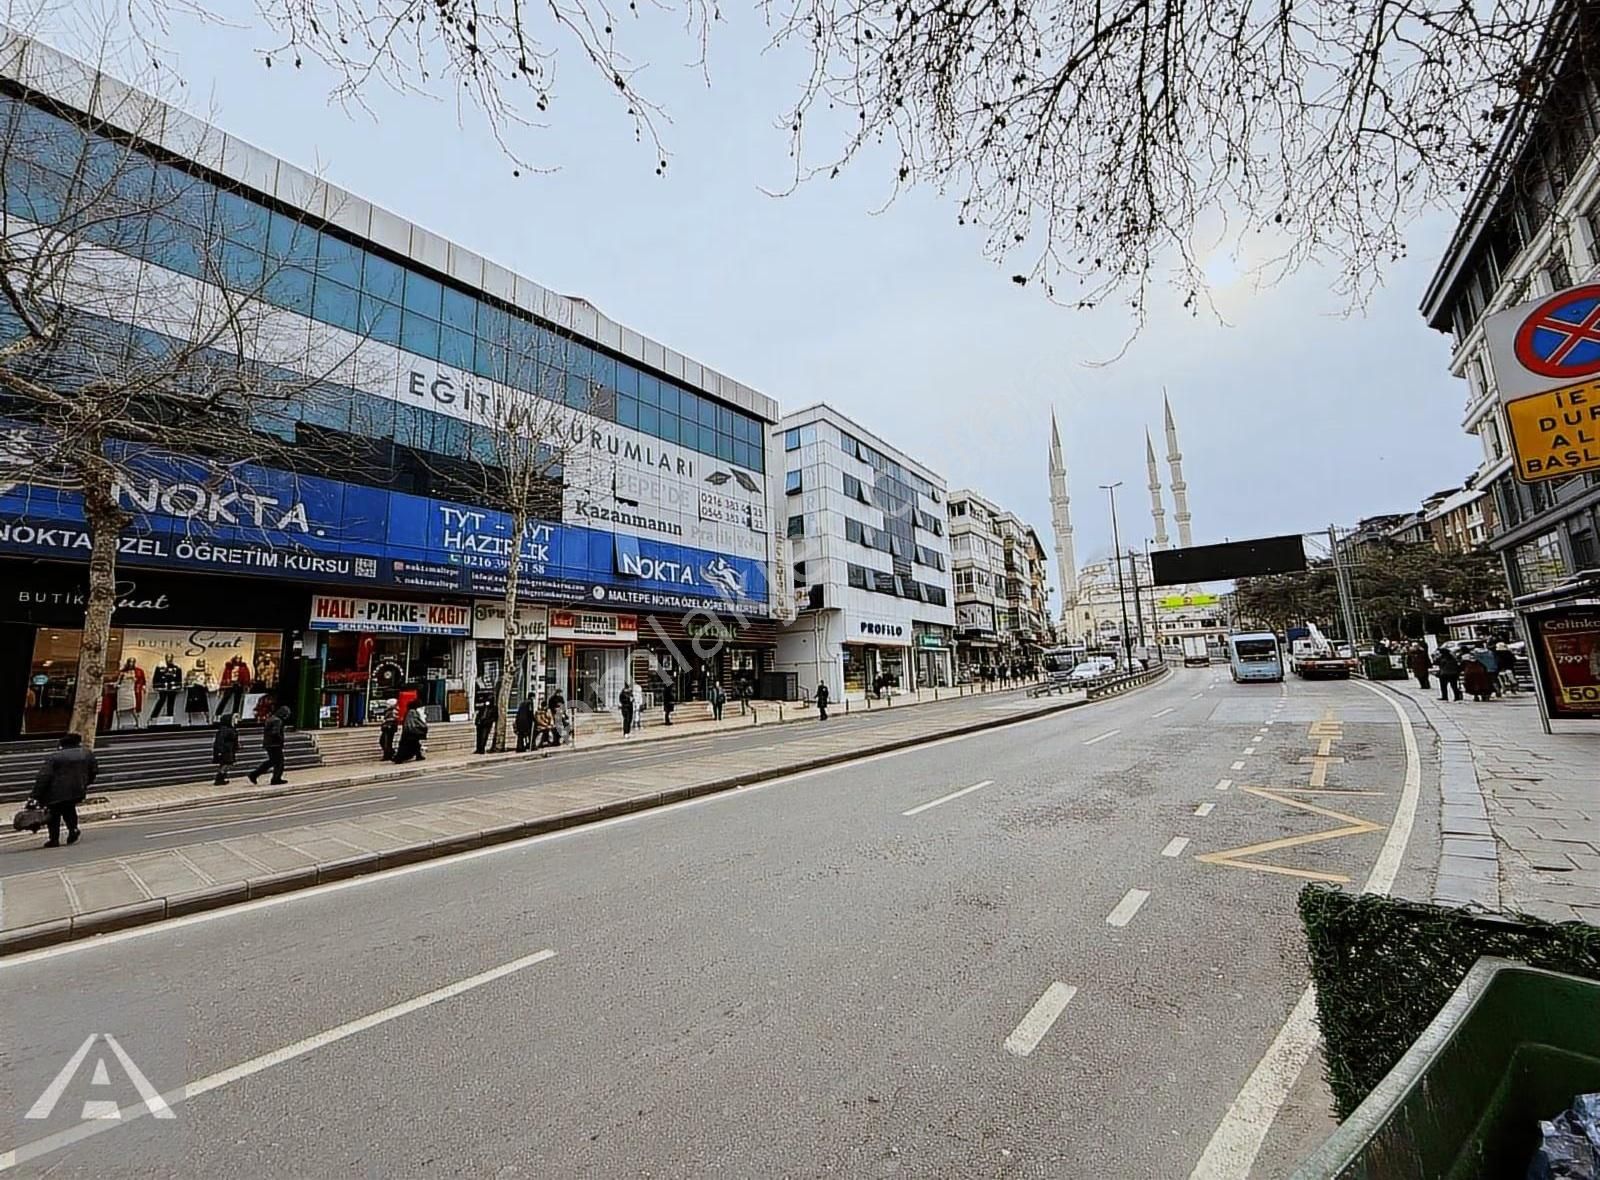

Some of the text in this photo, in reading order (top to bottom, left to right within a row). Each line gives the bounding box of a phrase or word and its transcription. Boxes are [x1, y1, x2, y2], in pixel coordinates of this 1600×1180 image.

[1555, 384, 1600, 409] İE
[550, 415, 694, 478] KURUMLARI
[1551, 429, 1595, 450] AL
[1526, 449, 1600, 474] BAŞL
[440, 506, 485, 530] TYT
[575, 498, 683, 536] Kazanmanın
[176, 540, 278, 568] ÖĞRETİM
[283, 555, 350, 575] KURSU
[463, 555, 492, 568] 0216
[494, 558, 510, 571] 39
[532, 563, 545, 575] 58
[317, 598, 355, 619] HALI
[367, 602, 418, 622] PARKE
[608, 590, 651, 604] MALTEPE
[652, 594, 680, 608] NOKTA
[682, 596, 701, 609] ÖZEL
